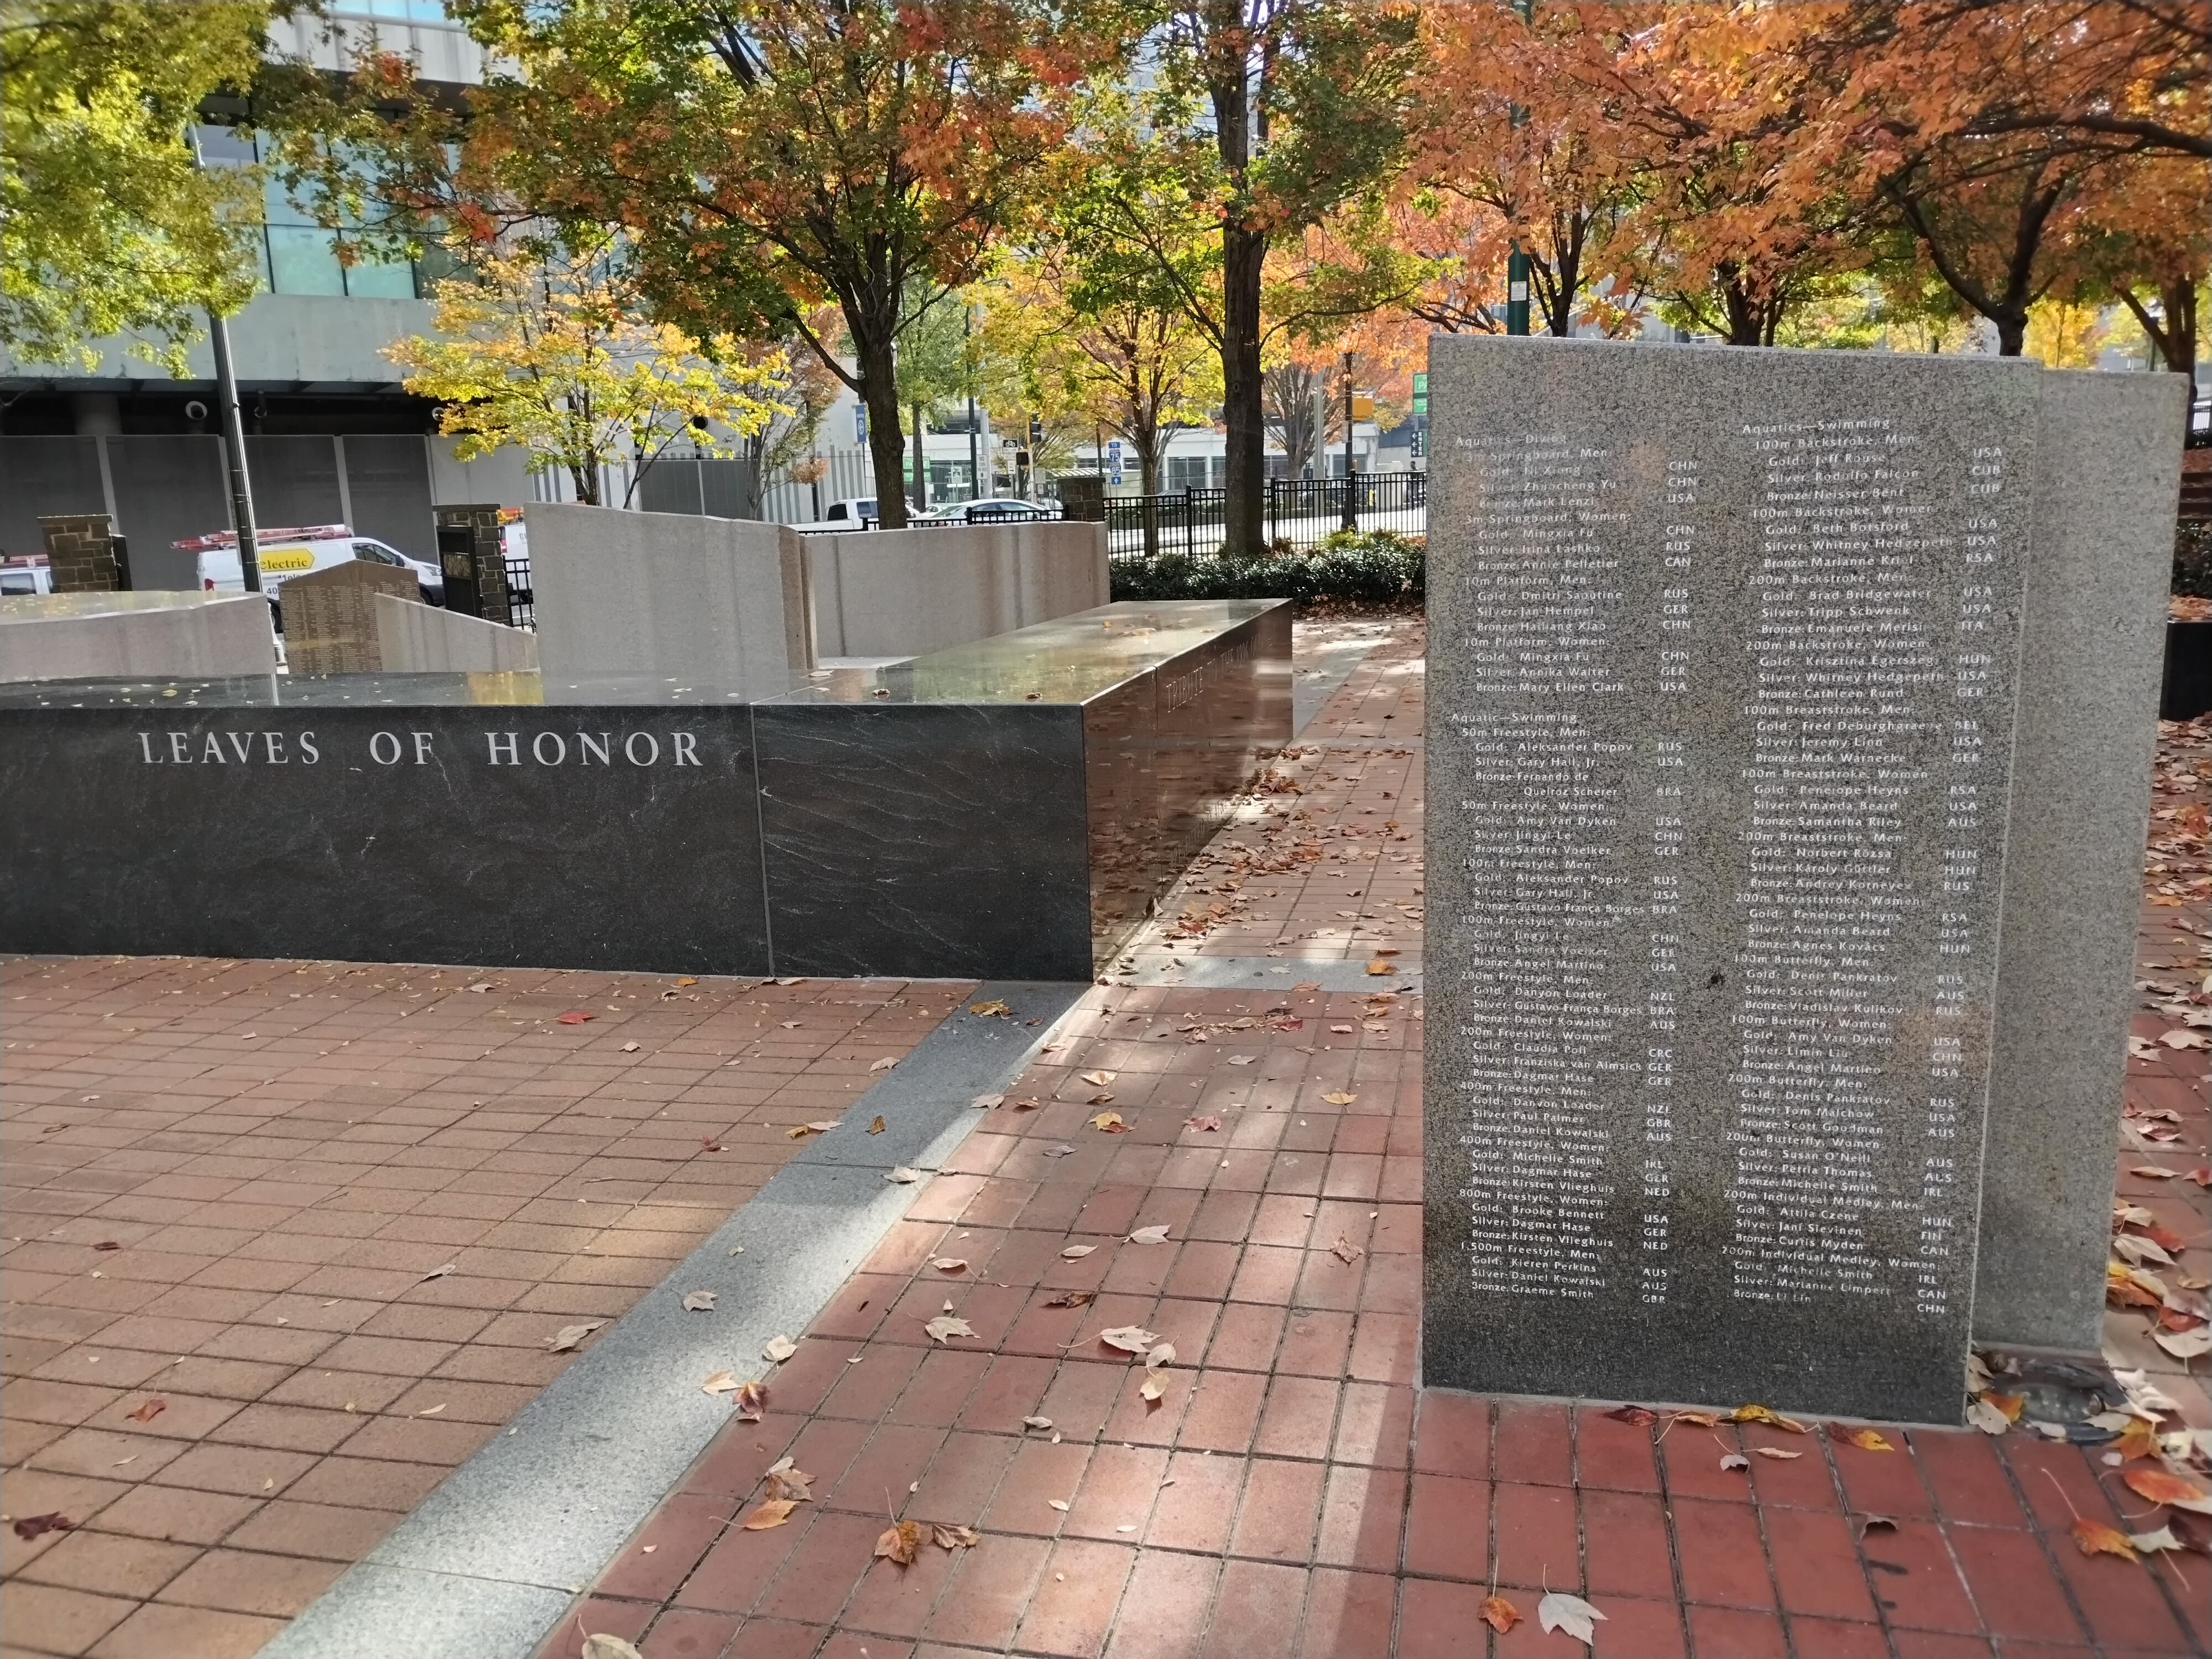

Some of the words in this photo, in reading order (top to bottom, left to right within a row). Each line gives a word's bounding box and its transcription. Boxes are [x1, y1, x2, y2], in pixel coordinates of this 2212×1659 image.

[1110, 453, 1119, 462] 75
[1111, 466, 1120, 474] 85
[1813, 523, 1843, 533] Beth
[1850, 521, 1909, 531] Botsford
[1969, 519, 1997, 528] USA
[260, 557, 307, 570] electric
[1521, 606, 1541, 617] Jan
[1545, 606, 1594, 618] Hempel
[1663, 604, 1688, 614] GER
[1808, 606, 1843, 618] Tripp
[1963, 604, 1991, 613] USA
[1808, 623, 1873, 633] Emanuele
[1880, 622, 1923, 632] Merisi
[1961, 620, 1983, 630] ITA
[1746, 640, 1782, 650] 200m
[1519, 683, 1551, 695] Mary
[1556, 682, 1585, 692] Ellen
[1593, 682, 1624, 691] Clark
[1661, 682, 1686, 691] USA
[1745, 705, 1778, 714] 100m
[1462, 728, 1487, 737] 50m
[137, 731, 319, 765] LEAVES
[369, 731, 433, 765] OF
[484, 731, 704, 766] HONOR
[1518, 743, 1587, 752] Aleksander
[1594, 743, 1632, 754] Popov
[1658, 742, 1682, 752] RUS
[1802, 737, 1847, 748] Jeremy
[1855, 737, 1882, 747] Linn
[1954, 737, 1981, 747] USA
[1517, 757, 1547, 769] Gary
[1657, 757, 1683, 766] USA
[1798, 817, 1862, 827] Samantha
[1869, 817, 1902, 828] Riley
[1948, 817, 1976, 827] AUS
[1516, 845, 1558, 855] Sandra
[1563, 846, 1610, 855] Voelker
[1655, 846, 1679, 855] GER
[1797, 848, 1846, 858] Norbert
[1946, 850, 1977, 859] HUN
[1796, 879, 1843, 891] Andrey
[1944, 881, 1970, 891] RUS
[1794, 910, 1854, 922] Penelope
[1861, 911, 1902, 922] Heyns
[1942, 912, 1967, 921] RSA
[1515, 987, 1559, 999] Danyon
[1566, 990, 1607, 1000] Loader
[1651, 992, 1675, 1001] NZL
[1790, 1002, 1848, 1012] Vladislav
[1854, 1004, 1903, 1014] Kulikov
[1936, 1006, 1960, 1015] RUS
[1515, 1014, 1552, 1024] Daniel
[1558, 1017, 1611, 1027] Kowalski
[1650, 1021, 1675, 1030] AUS
[1514, 1057, 1565, 1067] Franziska
[1571, 1060, 1591, 1069] van
[1597, 1061, 1641, 1071] Almsick
[1648, 1062, 1672, 1072] GER
[1787, 1062, 1824, 1073] Angel
[1831, 1064, 1881, 1074] Martino
[1932, 1067, 1958, 1077] USA
[1786, 1091, 1820, 1100] Denis
[1931, 1098, 1955, 1107] RUS
[1514, 1125, 1551, 1135] Daniel
[1556, 1128, 1609, 1138] Kowalski
[1646, 1133, 1672, 1141] AUS
[1460, 1135, 1491, 1145] 400m
[1782, 1150, 1818, 1160] Susan
[1825, 1151, 1870, 1162] O'Neill
[1926, 1158, 1953, 1167] AUS
[1459, 1188, 1491, 1198] 800m
[1512, 1178, 1554, 1189] Kirsten
[1559, 1181, 1615, 1194] Vlieghuis
[1645, 1187, 1670, 1196] NED
[1781, 1179, 1835, 1190] Michelle
[1841, 1182, 1877, 1193] Smith
[1924, 1188, 1943, 1197] IRL
[1724, 1190, 1757, 1199] 200m
[1764, 1191, 1827, 1204] Individual
[1512, 1205, 1553, 1215] Brooke
[1558, 1208, 1604, 1219] Bennett
[1644, 1214, 1668, 1223] USA
[1780, 1207, 1815, 1218] Attila
[1821, 1210, 1859, 1220] Czene
[1923, 1217, 1952, 1227] HUN
[1779, 1236, 1815, 1246] Curtis
[1821, 1239, 1864, 1250] Myden
[1921, 1245, 1948, 1255] CAN
[1722, 1246, 1755, 1256] 200m
[1761, 1249, 1824, 1261] Individual
[1511, 1258, 1548, 1269] Kieren
[1554, 1261, 1596, 1272] Perkins
[1643, 1268, 1667, 1277] AUS
